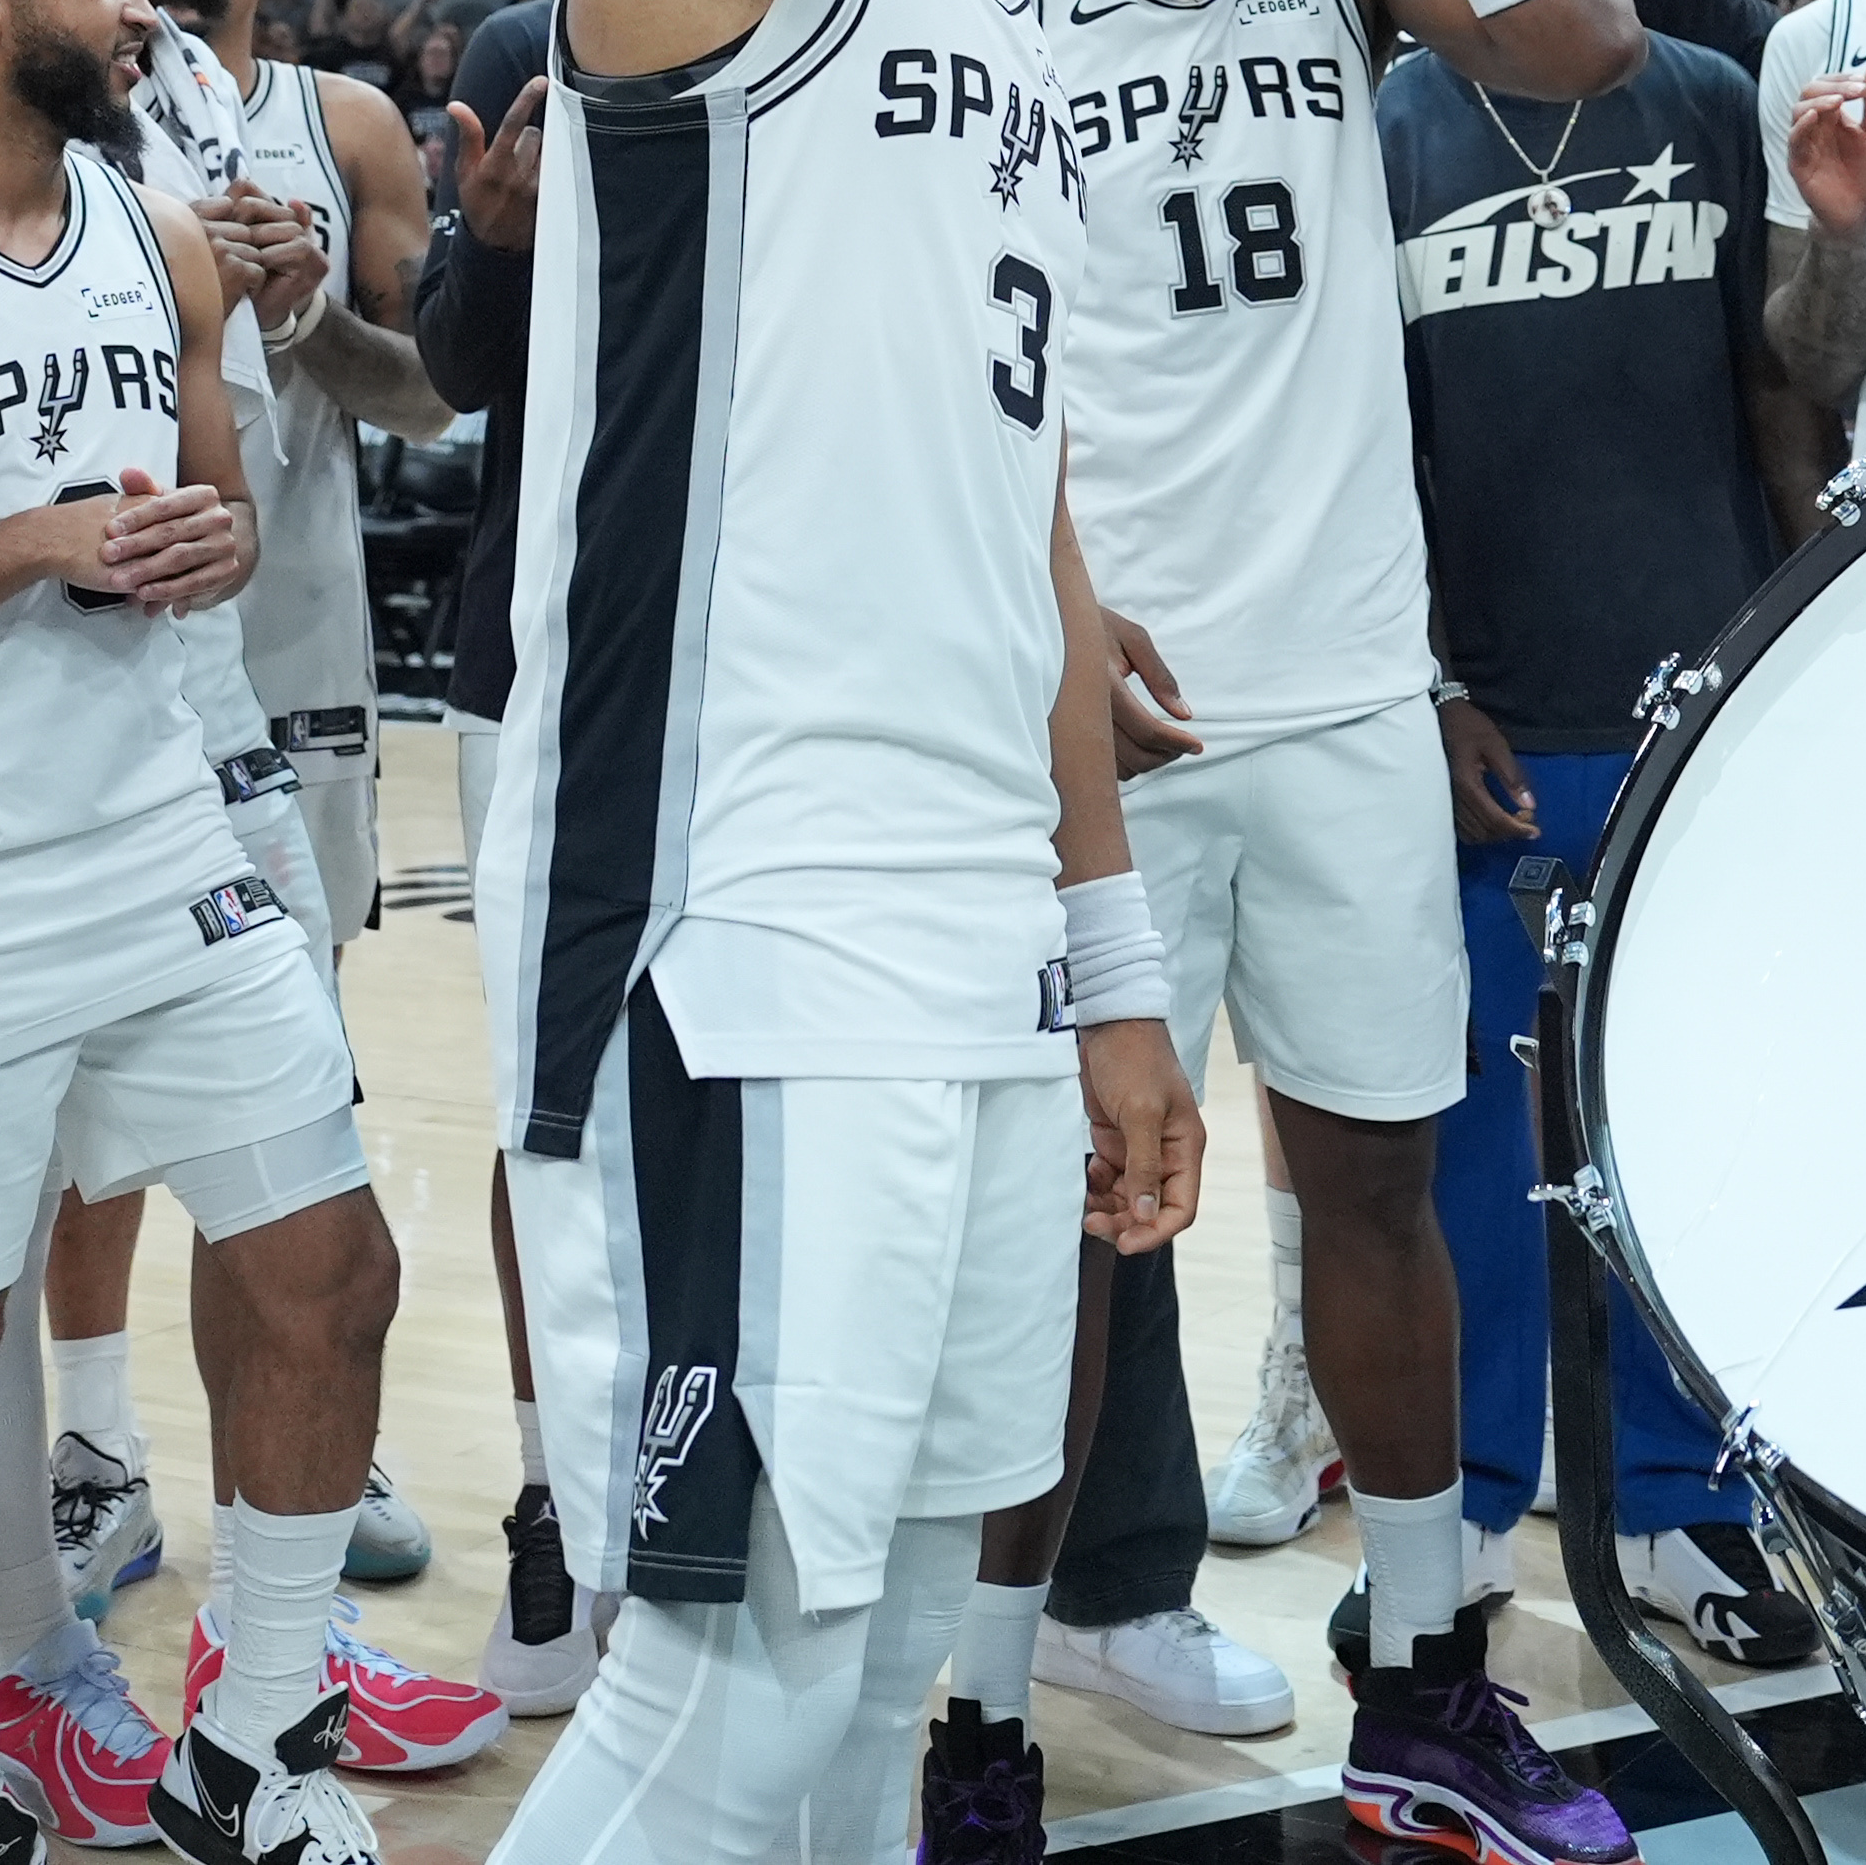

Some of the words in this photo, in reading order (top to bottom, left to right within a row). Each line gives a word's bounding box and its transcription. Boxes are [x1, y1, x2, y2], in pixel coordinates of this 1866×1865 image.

[255, 148, 296, 160] EDGER
[1069, 56, 1344, 171] SPURS
[92, 289, 144, 310] LEDGER
[1157, 175, 1307, 319] 18
[986, 245, 1053, 442] 3
